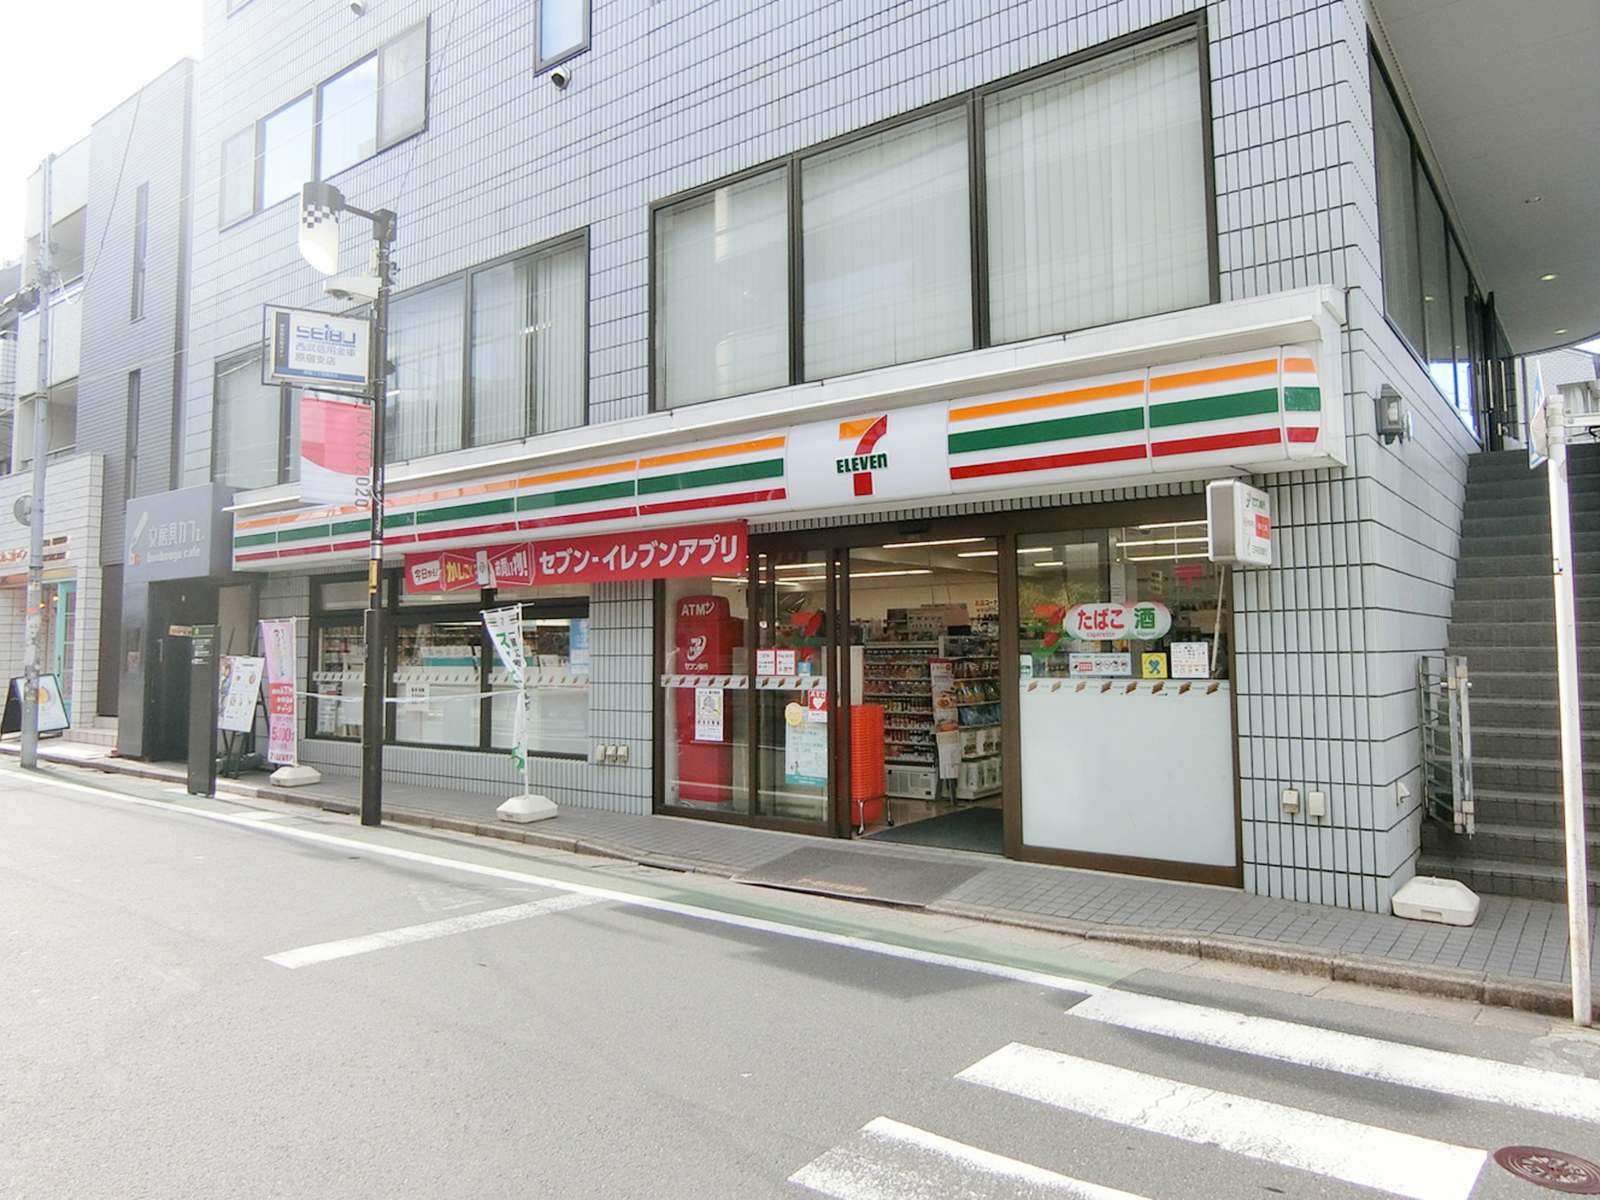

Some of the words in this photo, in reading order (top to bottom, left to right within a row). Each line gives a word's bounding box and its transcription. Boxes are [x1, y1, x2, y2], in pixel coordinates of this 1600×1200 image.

[295, 342, 356, 357] 西武信用金庫
[294, 353, 336, 366] 原宿支店
[148, 520, 205, 549] 文房具カフェ
[680, 603, 707, 616] ATM
[1077, 607, 1125, 631] たばこ
[1133, 607, 1156, 629] 酒
